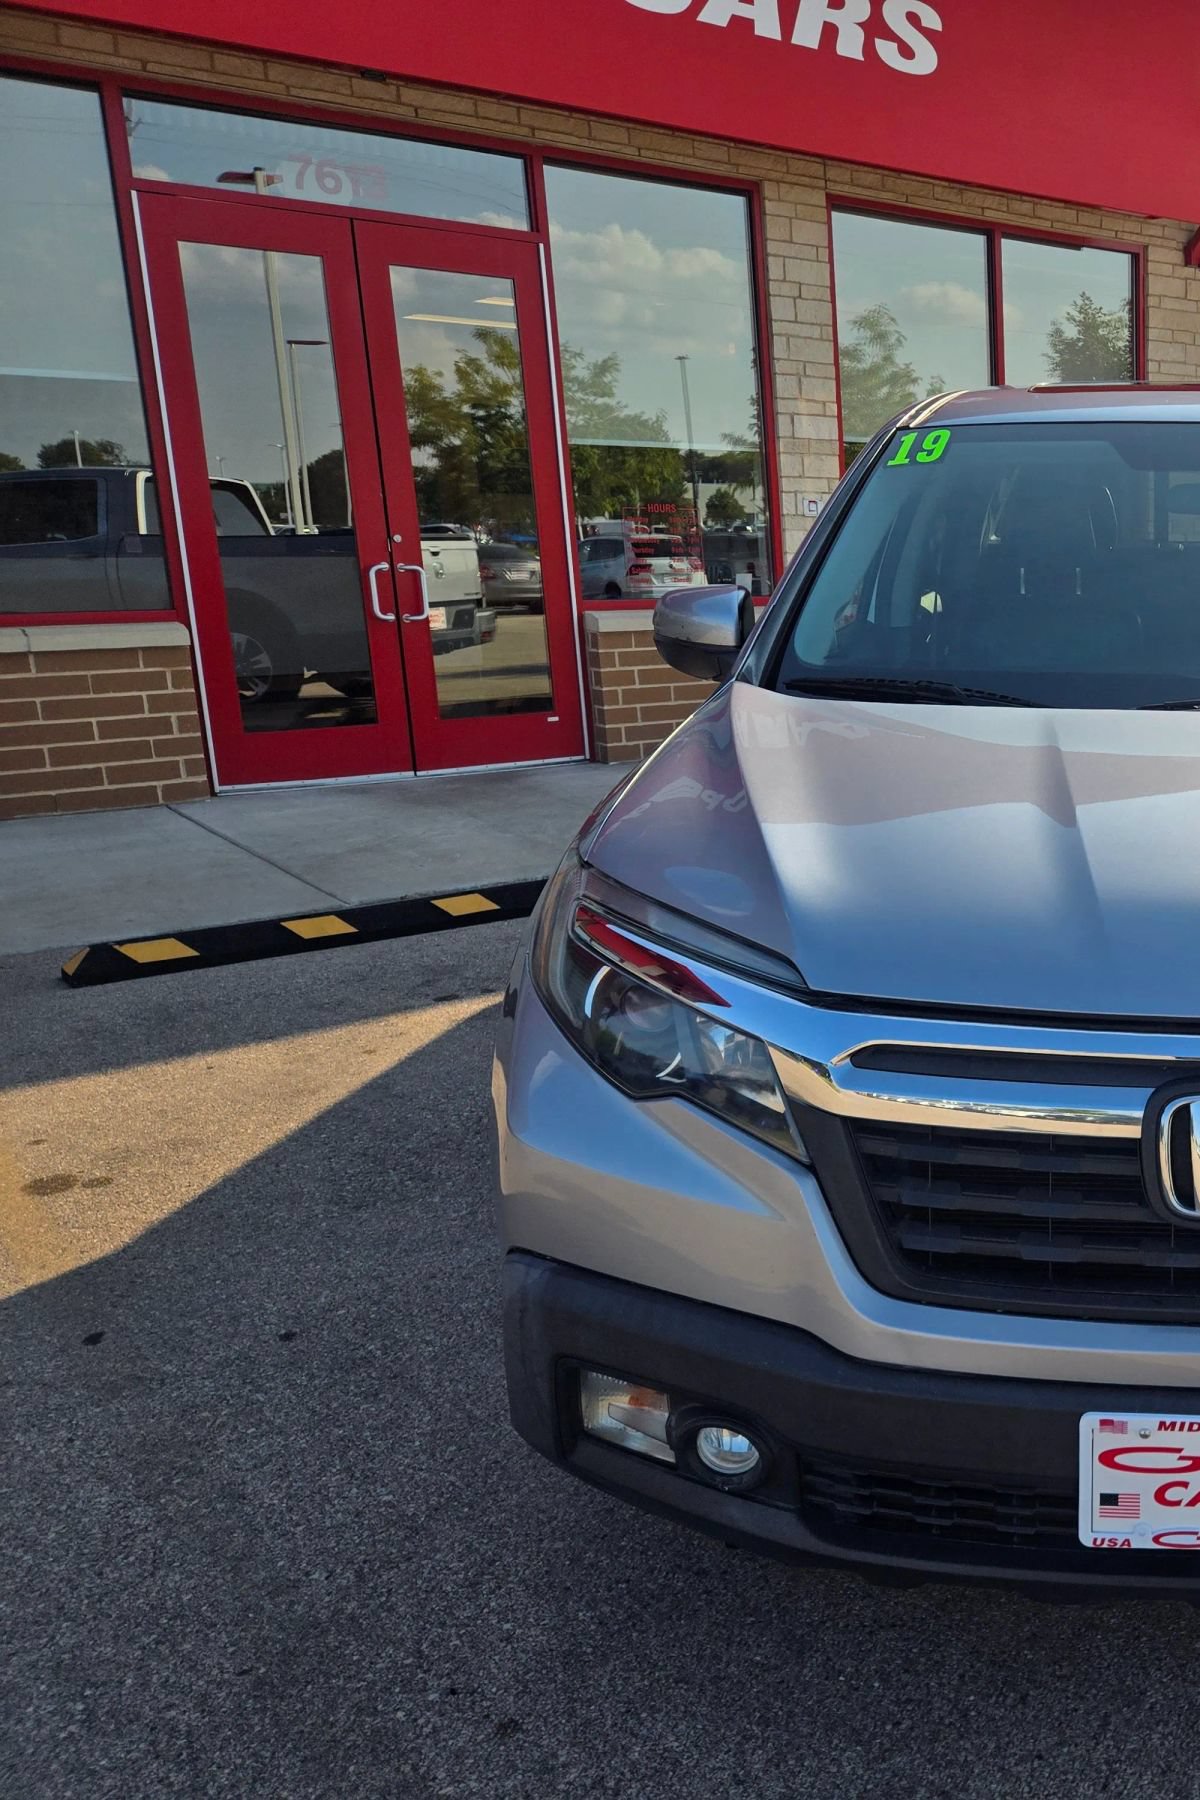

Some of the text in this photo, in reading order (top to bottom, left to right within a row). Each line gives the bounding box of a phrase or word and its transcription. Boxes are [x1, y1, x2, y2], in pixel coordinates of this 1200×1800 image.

[887, 429, 951, 466] 19
[647, 503, 677, 513] HOURS
[1092, 1537, 1132, 1549] USA
